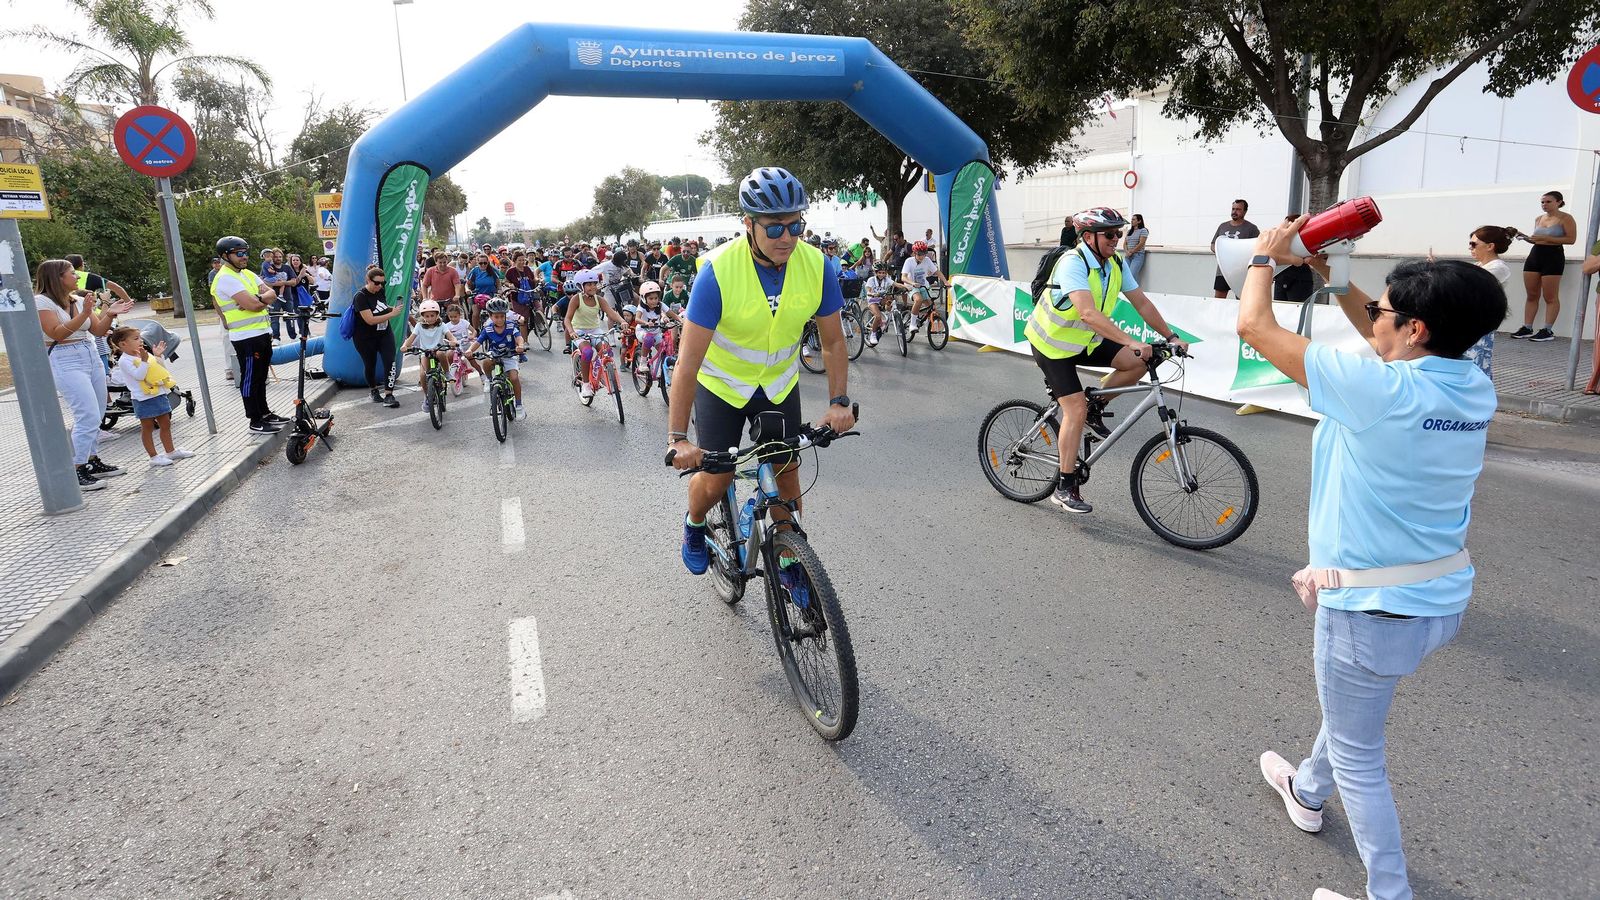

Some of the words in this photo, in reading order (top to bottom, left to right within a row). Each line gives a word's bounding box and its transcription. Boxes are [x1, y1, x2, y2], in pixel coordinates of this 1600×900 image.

[610, 44, 758, 60] Ayuntamiento
[762, 51, 785, 61] de
[789, 51, 837, 63] Jerez
[610, 57, 681, 68] Deportes
[962, 176, 985, 220] Inglés
[321, 229, 338, 237] PEATO
[958, 220, 974, 251] Corte
